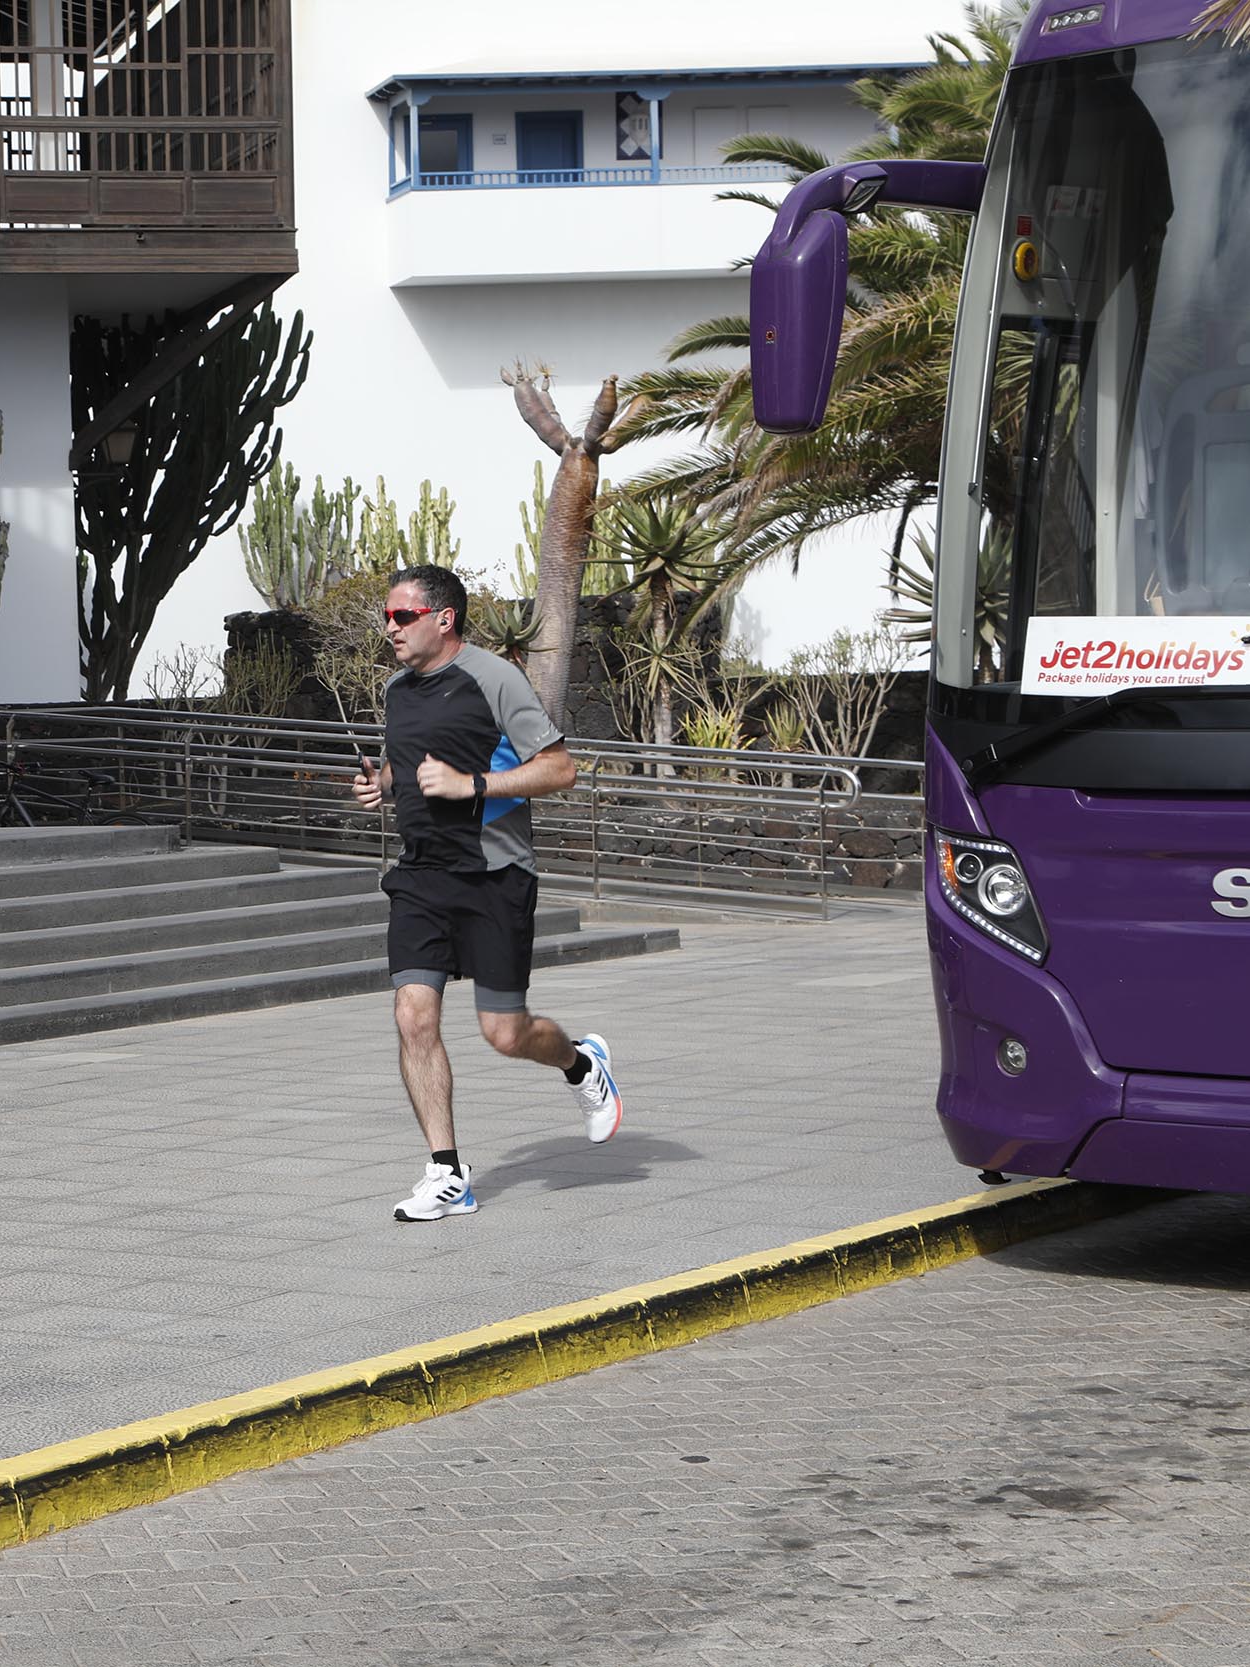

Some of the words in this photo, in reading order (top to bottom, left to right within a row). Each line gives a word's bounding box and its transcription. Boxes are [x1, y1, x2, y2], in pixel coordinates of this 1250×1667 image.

[1040, 640, 1246, 678] Jet2holidays
[1038, 672, 1083, 685] Package
[1084, 672, 1130, 685] holidays
[1132, 676, 1152, 685] you
[1154, 675, 1174, 684] can
[1177, 674, 1206, 685] trust
[1211, 868, 1250, 917] S
